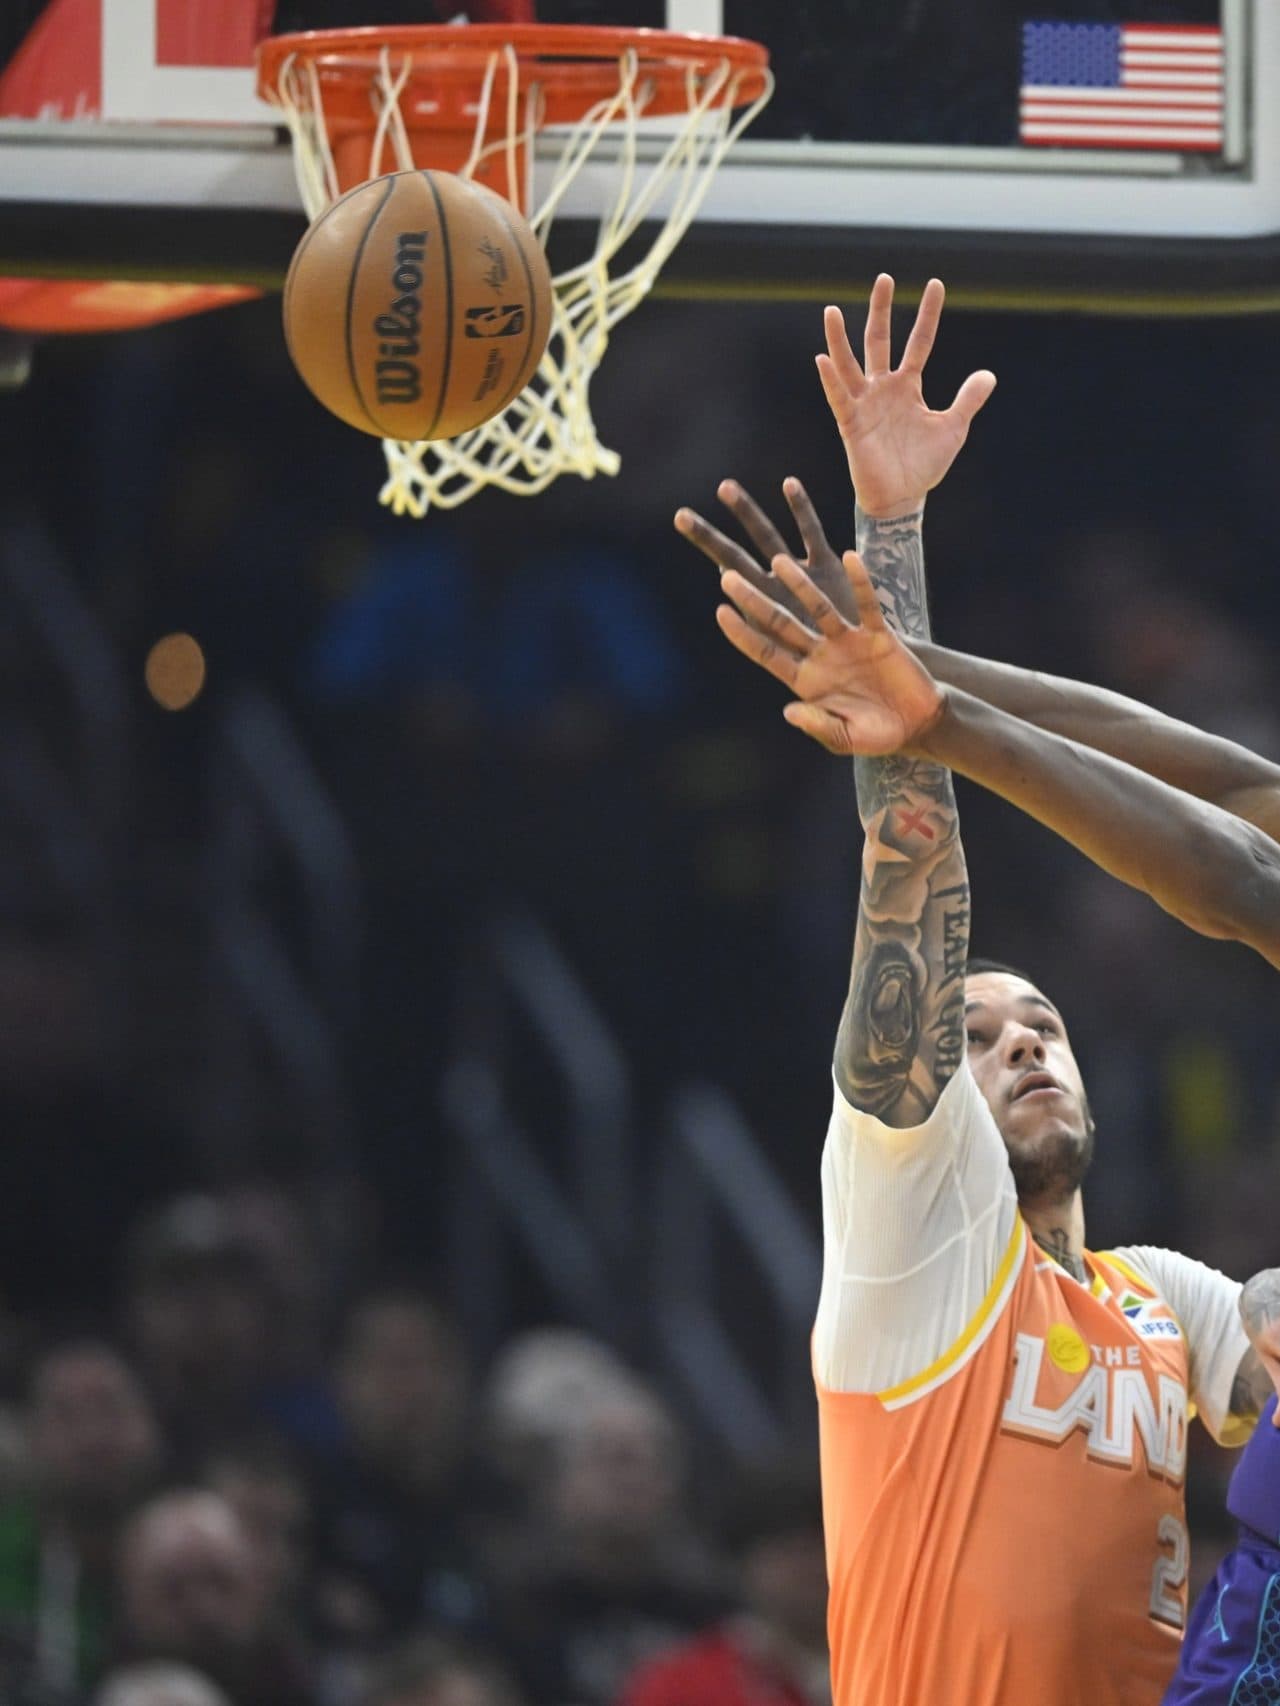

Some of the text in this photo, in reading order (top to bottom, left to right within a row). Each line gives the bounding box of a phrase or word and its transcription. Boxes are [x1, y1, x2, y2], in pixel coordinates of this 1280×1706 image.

[373, 231, 429, 405] Wilson
[1090, 1344, 1142, 1367] THE
[1139, 1321, 1180, 1335] IFFS
[1001, 1333, 1187, 1488] LAND
[1150, 1514, 1187, 1629] 2
